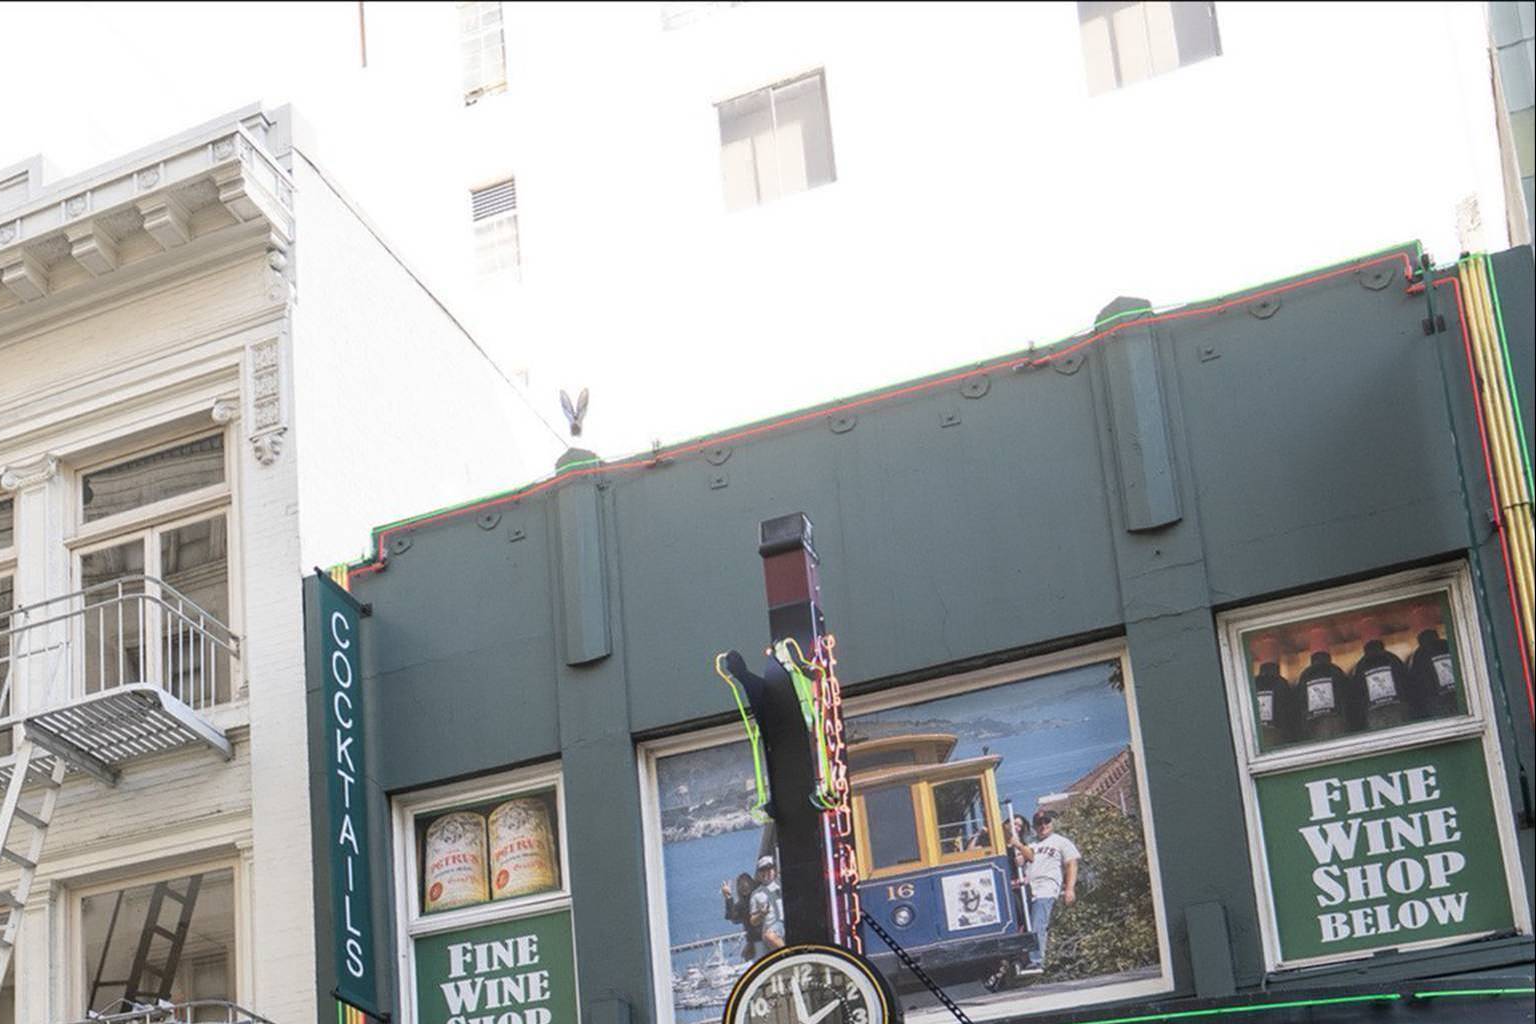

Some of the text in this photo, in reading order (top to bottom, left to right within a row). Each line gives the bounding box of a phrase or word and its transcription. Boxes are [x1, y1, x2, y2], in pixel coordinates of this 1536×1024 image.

[331, 611, 365, 979] COCKTAILS
[1305, 765, 1440, 821] FINE
[1298, 806, 1462, 864] WINE
[886, 883, 915, 901] 16
[1312, 851, 1466, 908] SHOP
[1317, 892, 1469, 943] BELOW
[447, 934, 540, 978] FINE
[793, 964, 813, 983] 12
[825, 967, 832, 986] 1
[440, 970, 551, 1015] WINE
[771, 975, 785, 995] 11
[846, 982, 860, 1001] 2
[749, 998, 769, 1018] 10
